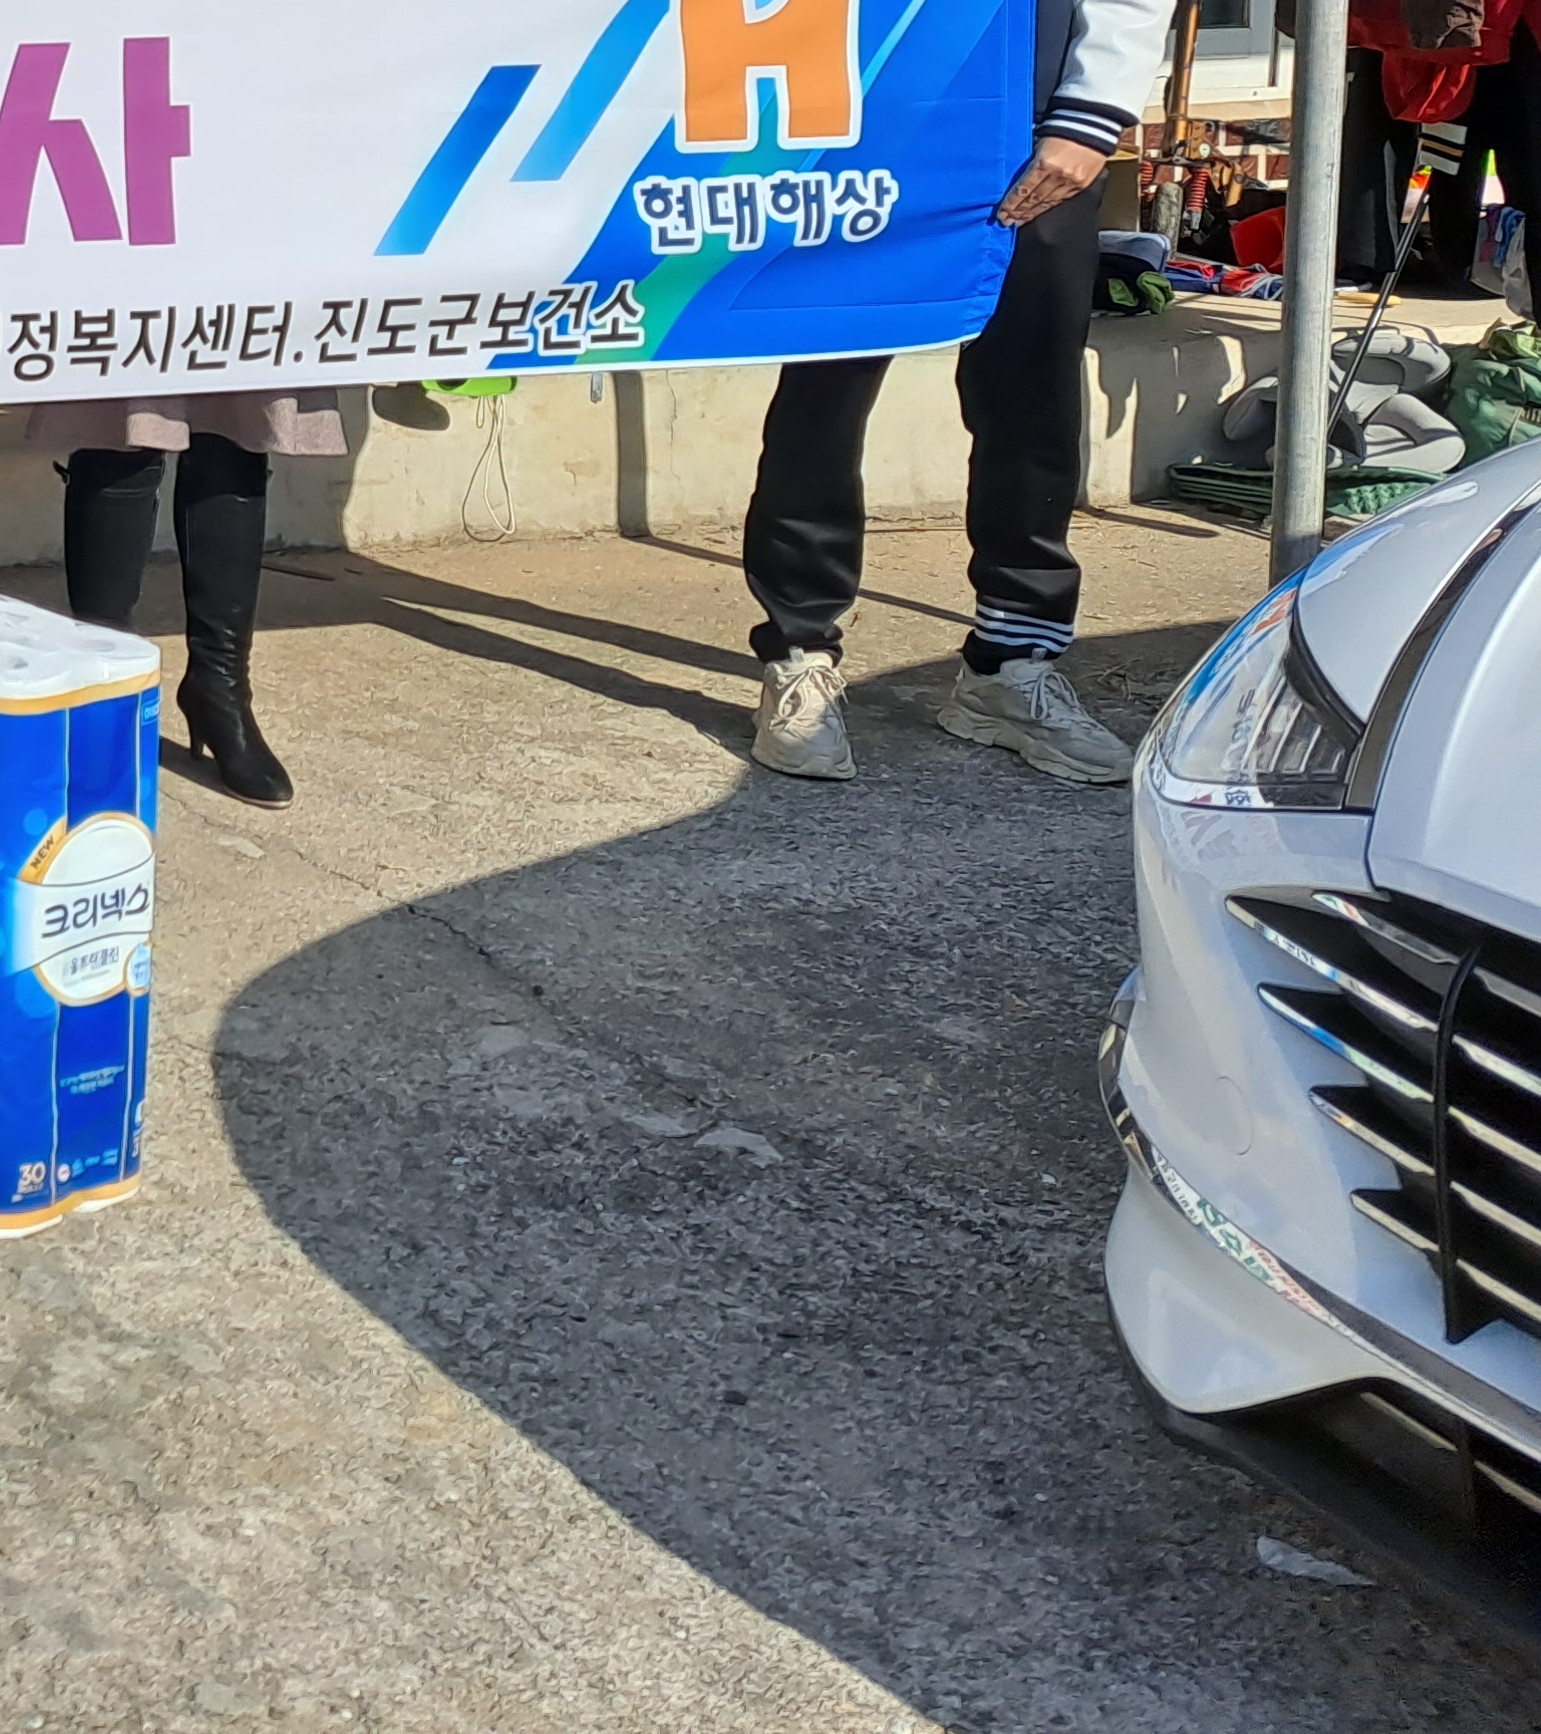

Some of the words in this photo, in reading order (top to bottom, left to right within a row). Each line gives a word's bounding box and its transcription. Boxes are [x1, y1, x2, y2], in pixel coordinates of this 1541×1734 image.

[639, 174, 893, 248] 현대해상
[30, 834, 55, 870] NEW
[40, 883, 151, 940] 크리넥스
[18, 1160, 46, 1186] 30
